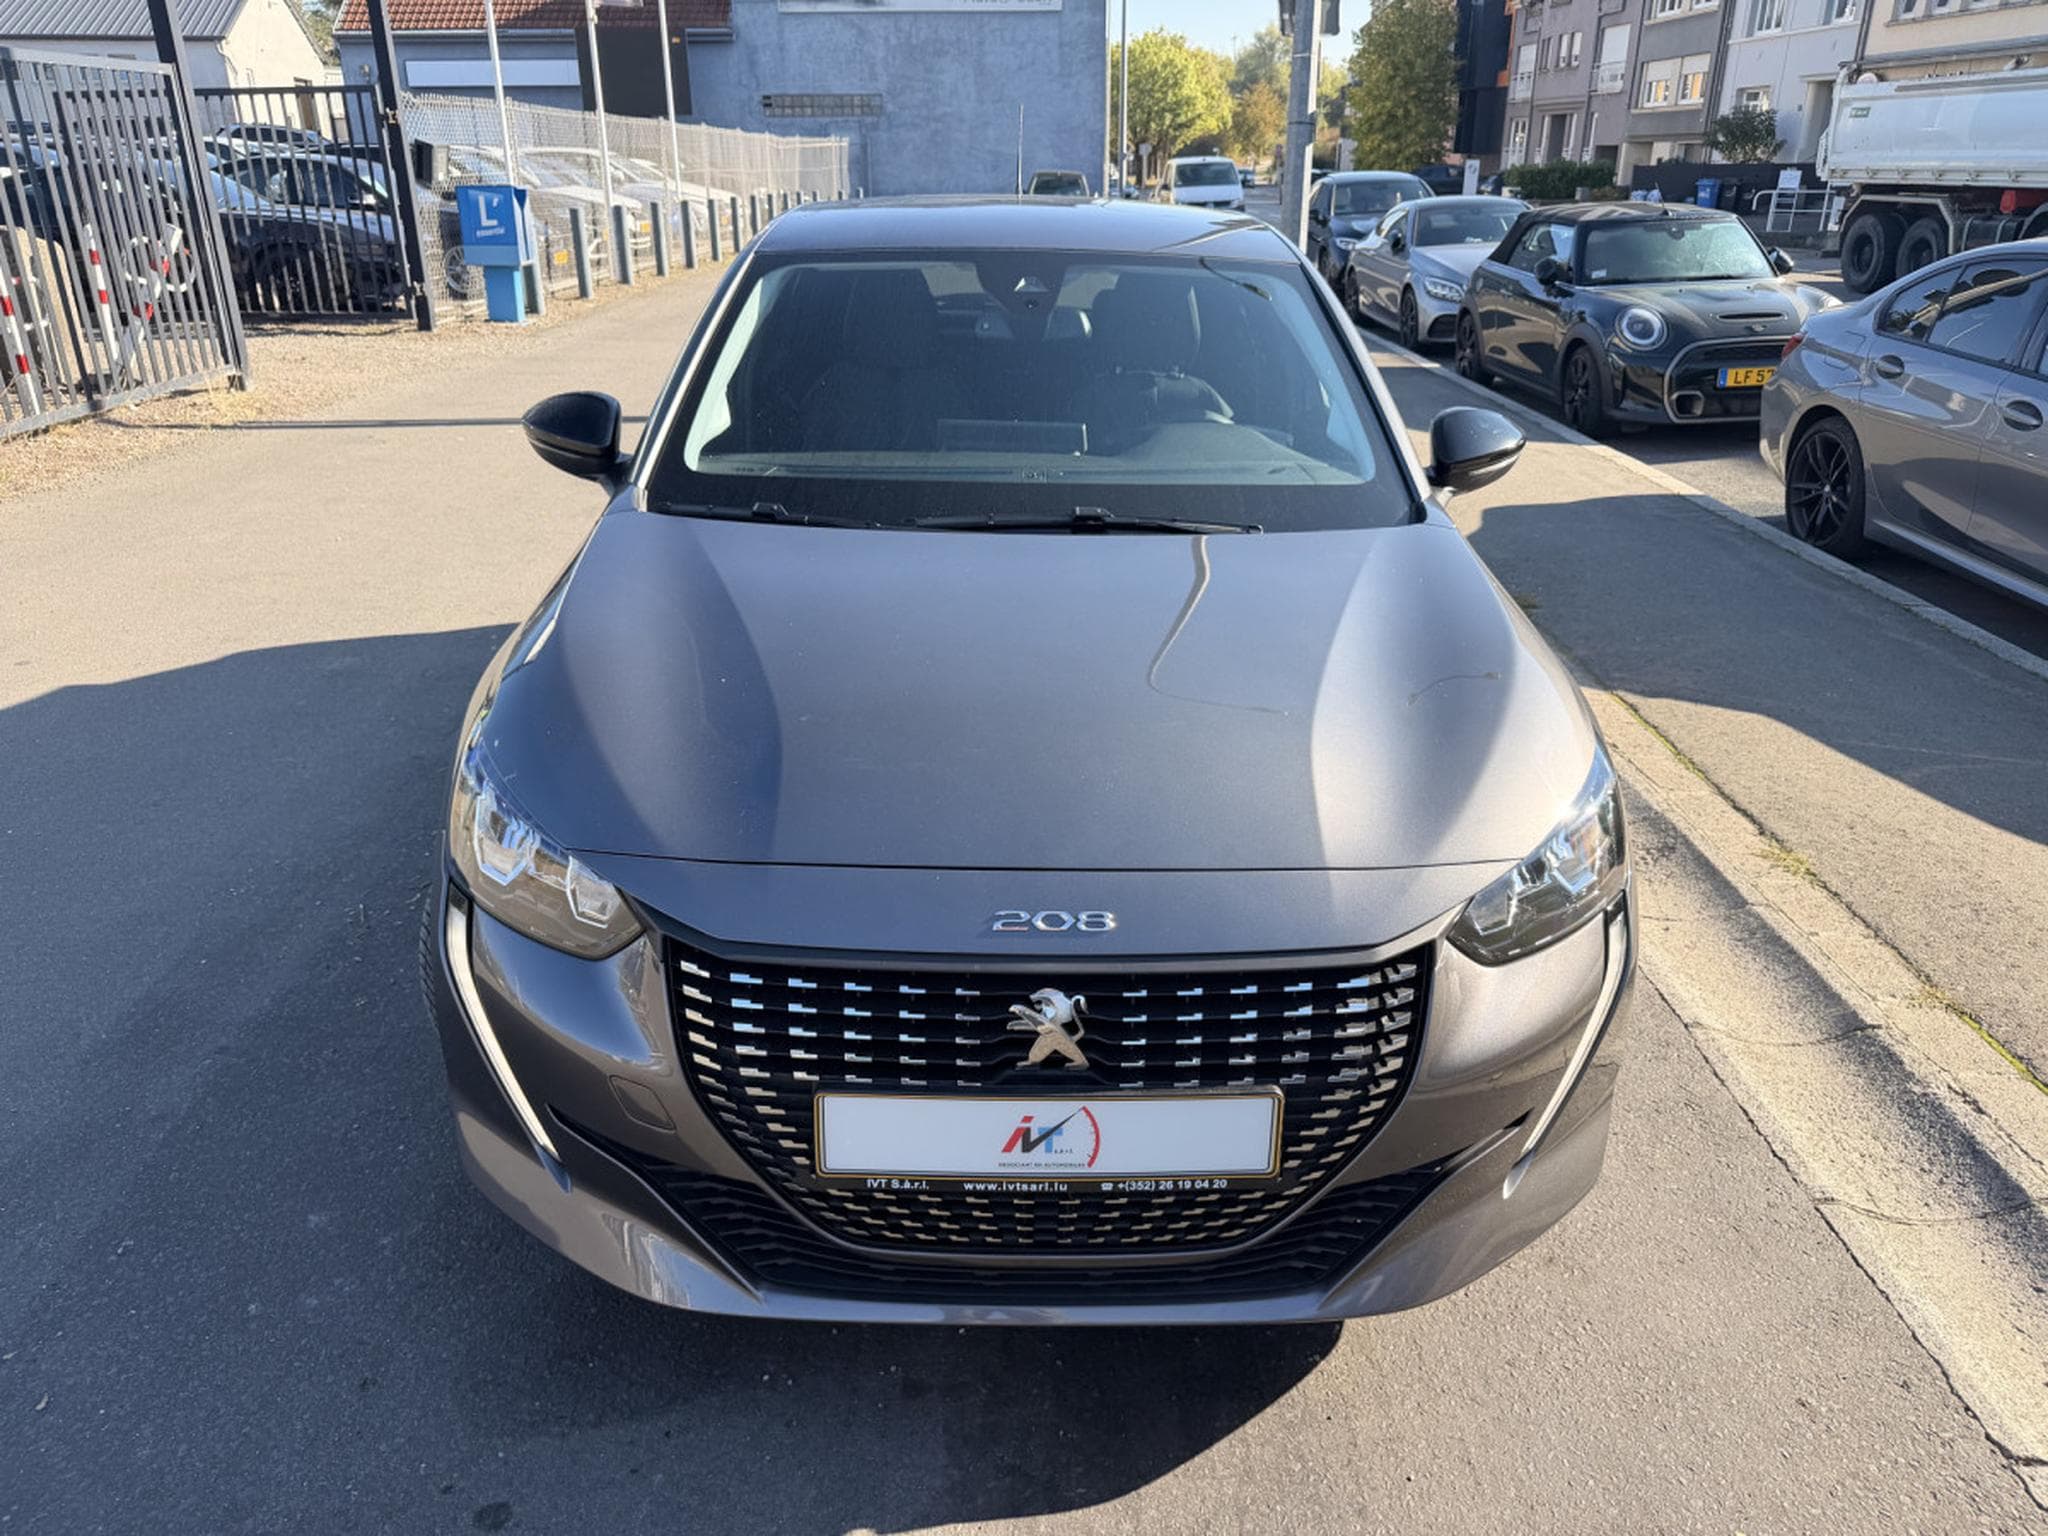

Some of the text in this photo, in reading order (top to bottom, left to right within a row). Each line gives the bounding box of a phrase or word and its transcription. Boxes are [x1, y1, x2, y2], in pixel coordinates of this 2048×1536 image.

[1734, 370, 1752, 384] LF
[992, 910, 1117, 931] 208
[866, 1179, 887, 1188] IVT
[963, 1181, 1068, 1191] www.ivtsarl.lu
[1117, 1180, 1155, 1191] +(352)
[1158, 1180, 1174, 1190] 26
[1178, 1180, 1192, 1189] 19
[1194, 1179, 1209, 1188] 04
[1212, 1179, 1228, 1188] 20
